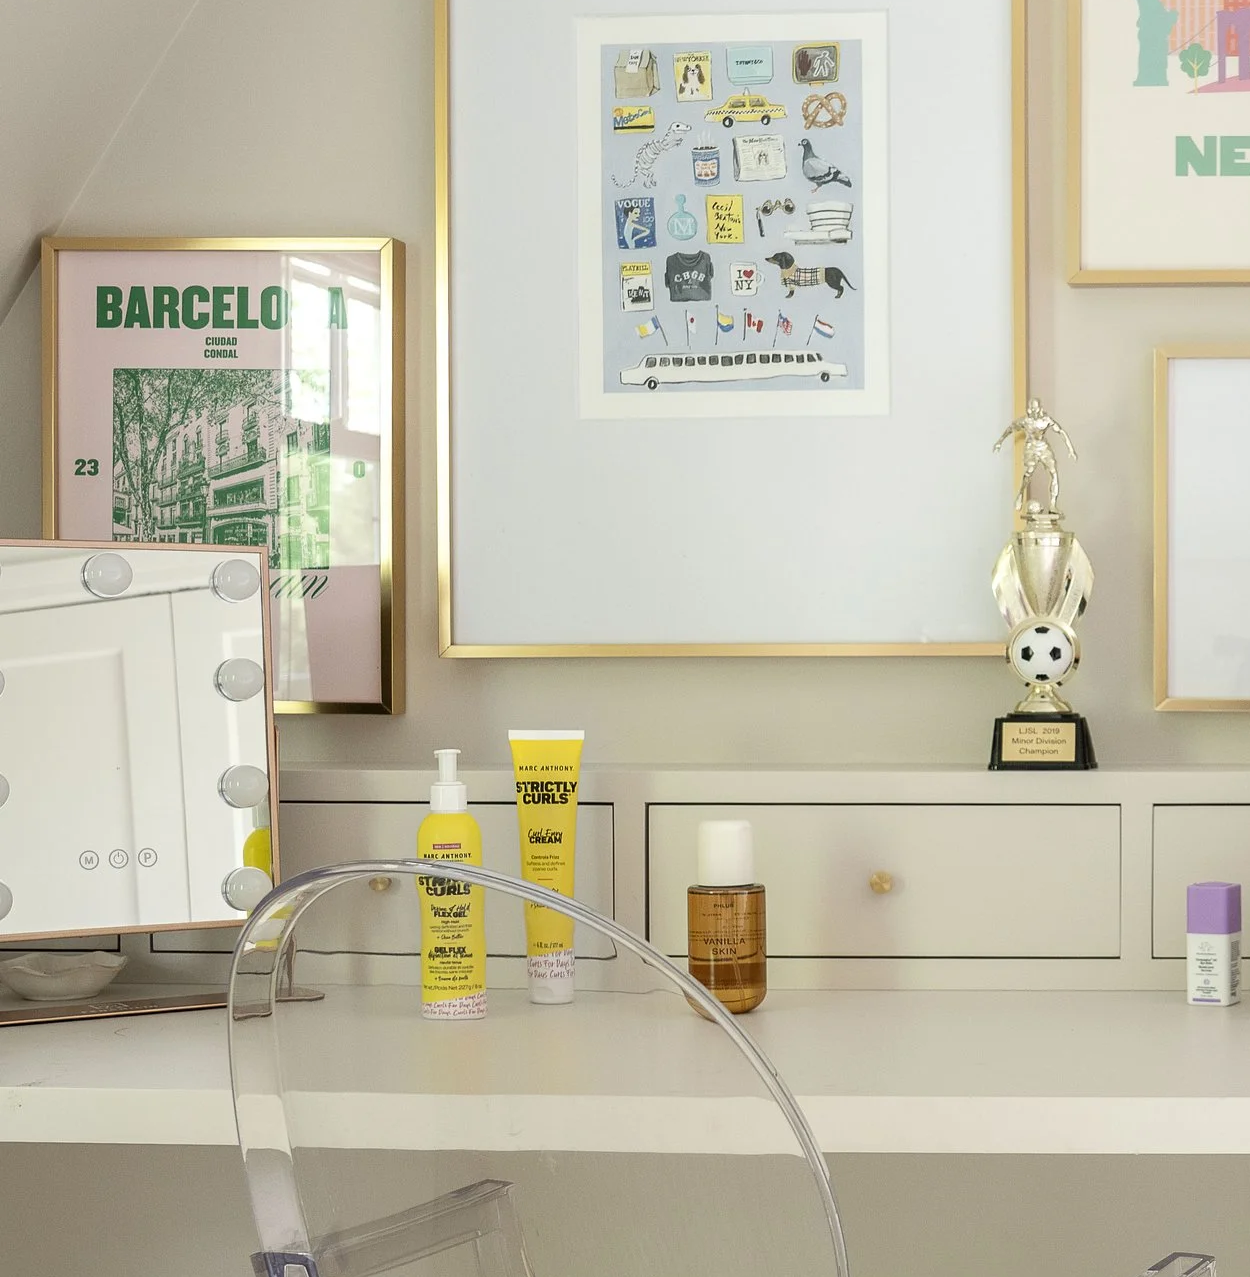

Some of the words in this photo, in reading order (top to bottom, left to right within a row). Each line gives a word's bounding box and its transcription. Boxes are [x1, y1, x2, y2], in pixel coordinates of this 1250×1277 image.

[617, 198, 651, 209] VOGUE
[673, 217, 696, 236] M
[673, 270, 706, 284] CBGB
[734, 279, 755, 292] NY
[95, 285, 349, 331] BARCELOA
[204, 336, 239, 348] CIUDAD
[203, 348, 239, 360] CONDAL
[74, 458, 100, 477] 23
[1042, 727, 1060, 735] 2019
[1011, 737, 1034, 745] Minor
[1036, 737, 1067, 745] Division
[1018, 747, 1059, 756] Champion
[515, 780, 578, 793] STRICTLY
[522, 792, 570, 805] CURLS
[529, 836, 562, 844] CREAM
[84, 856, 95, 865] M
[143, 852, 152, 863] P
[425, 882, 471, 897] CURLS
[703, 937, 747, 946] VANILLA
[711, 947, 738, 955] SKIN
